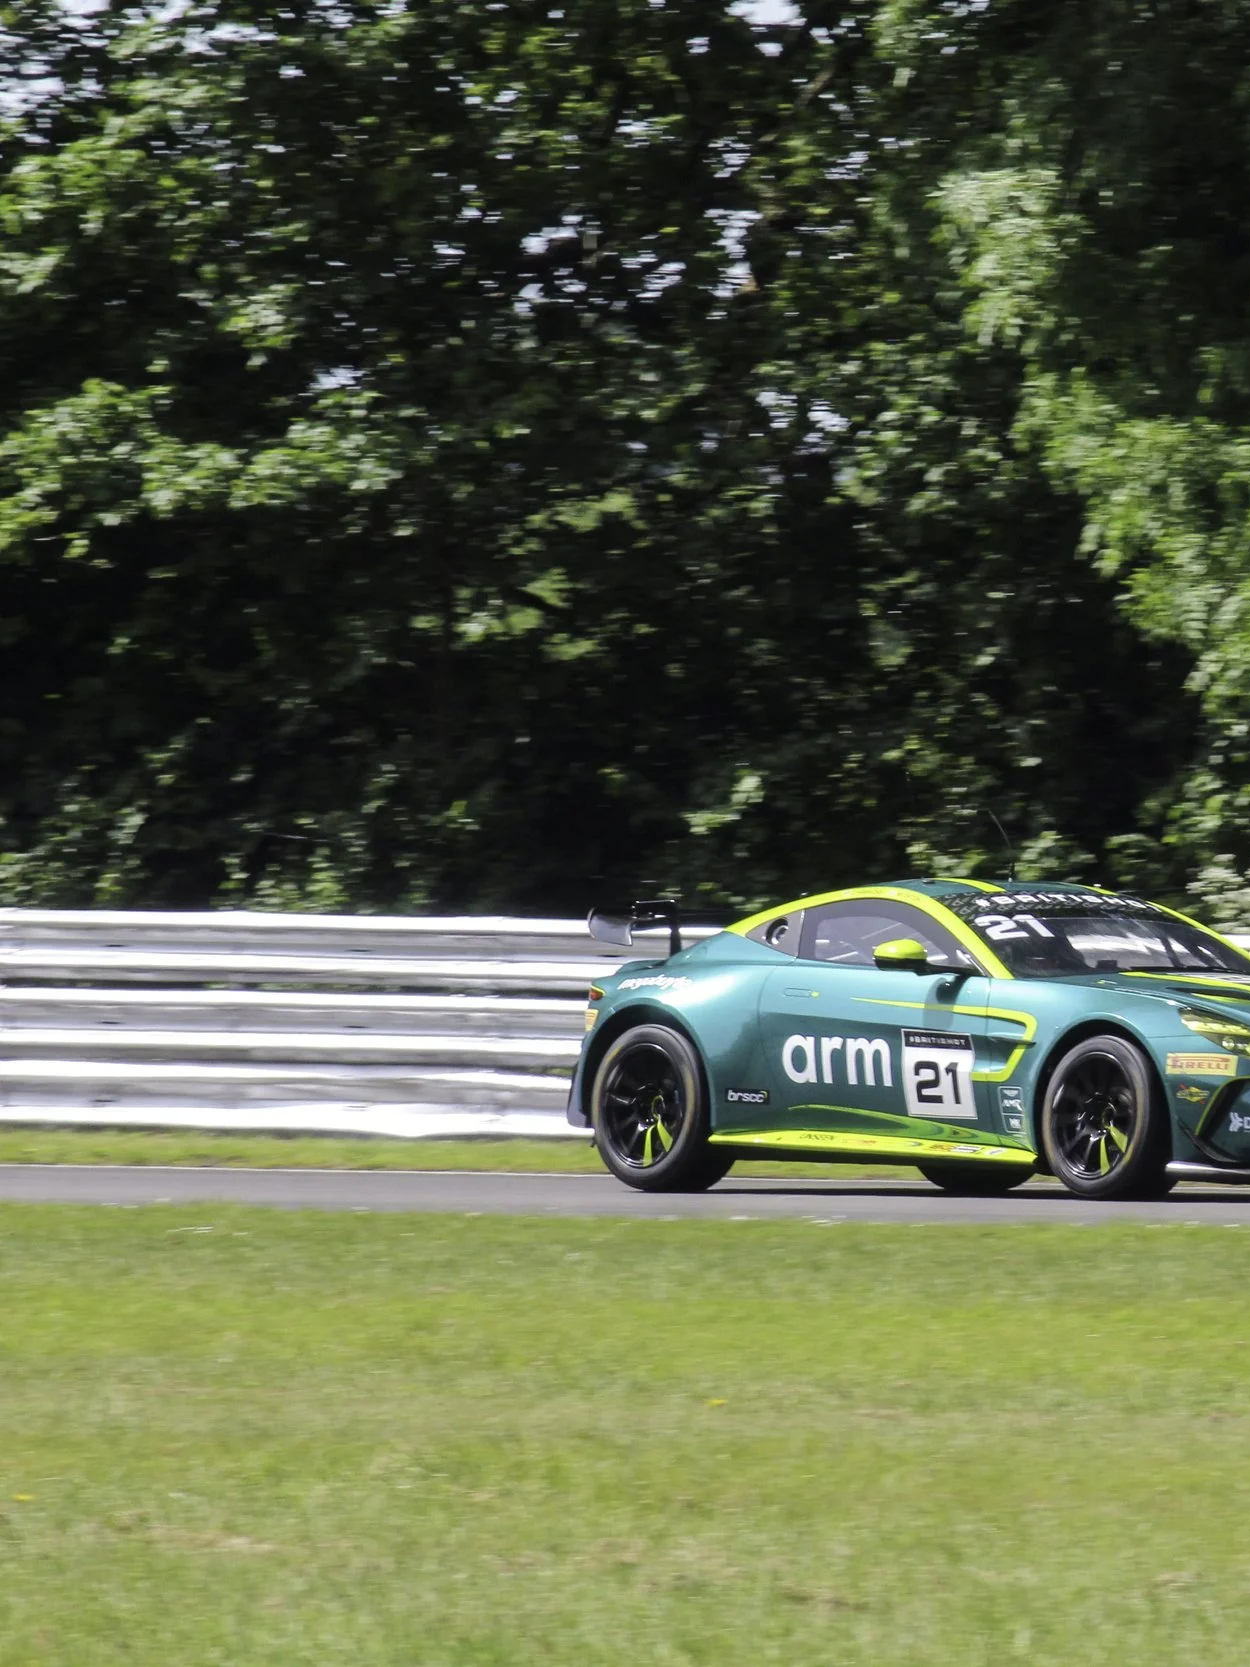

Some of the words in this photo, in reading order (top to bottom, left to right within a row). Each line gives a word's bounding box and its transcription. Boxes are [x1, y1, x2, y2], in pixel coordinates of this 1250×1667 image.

[973, 914, 1055, 940] 21
[782, 1034, 893, 1087] arm
[1171, 1056, 1231, 1070] PIRELLI
[914, 1060, 962, 1105] 21
[727, 1089, 765, 1103] brscc
